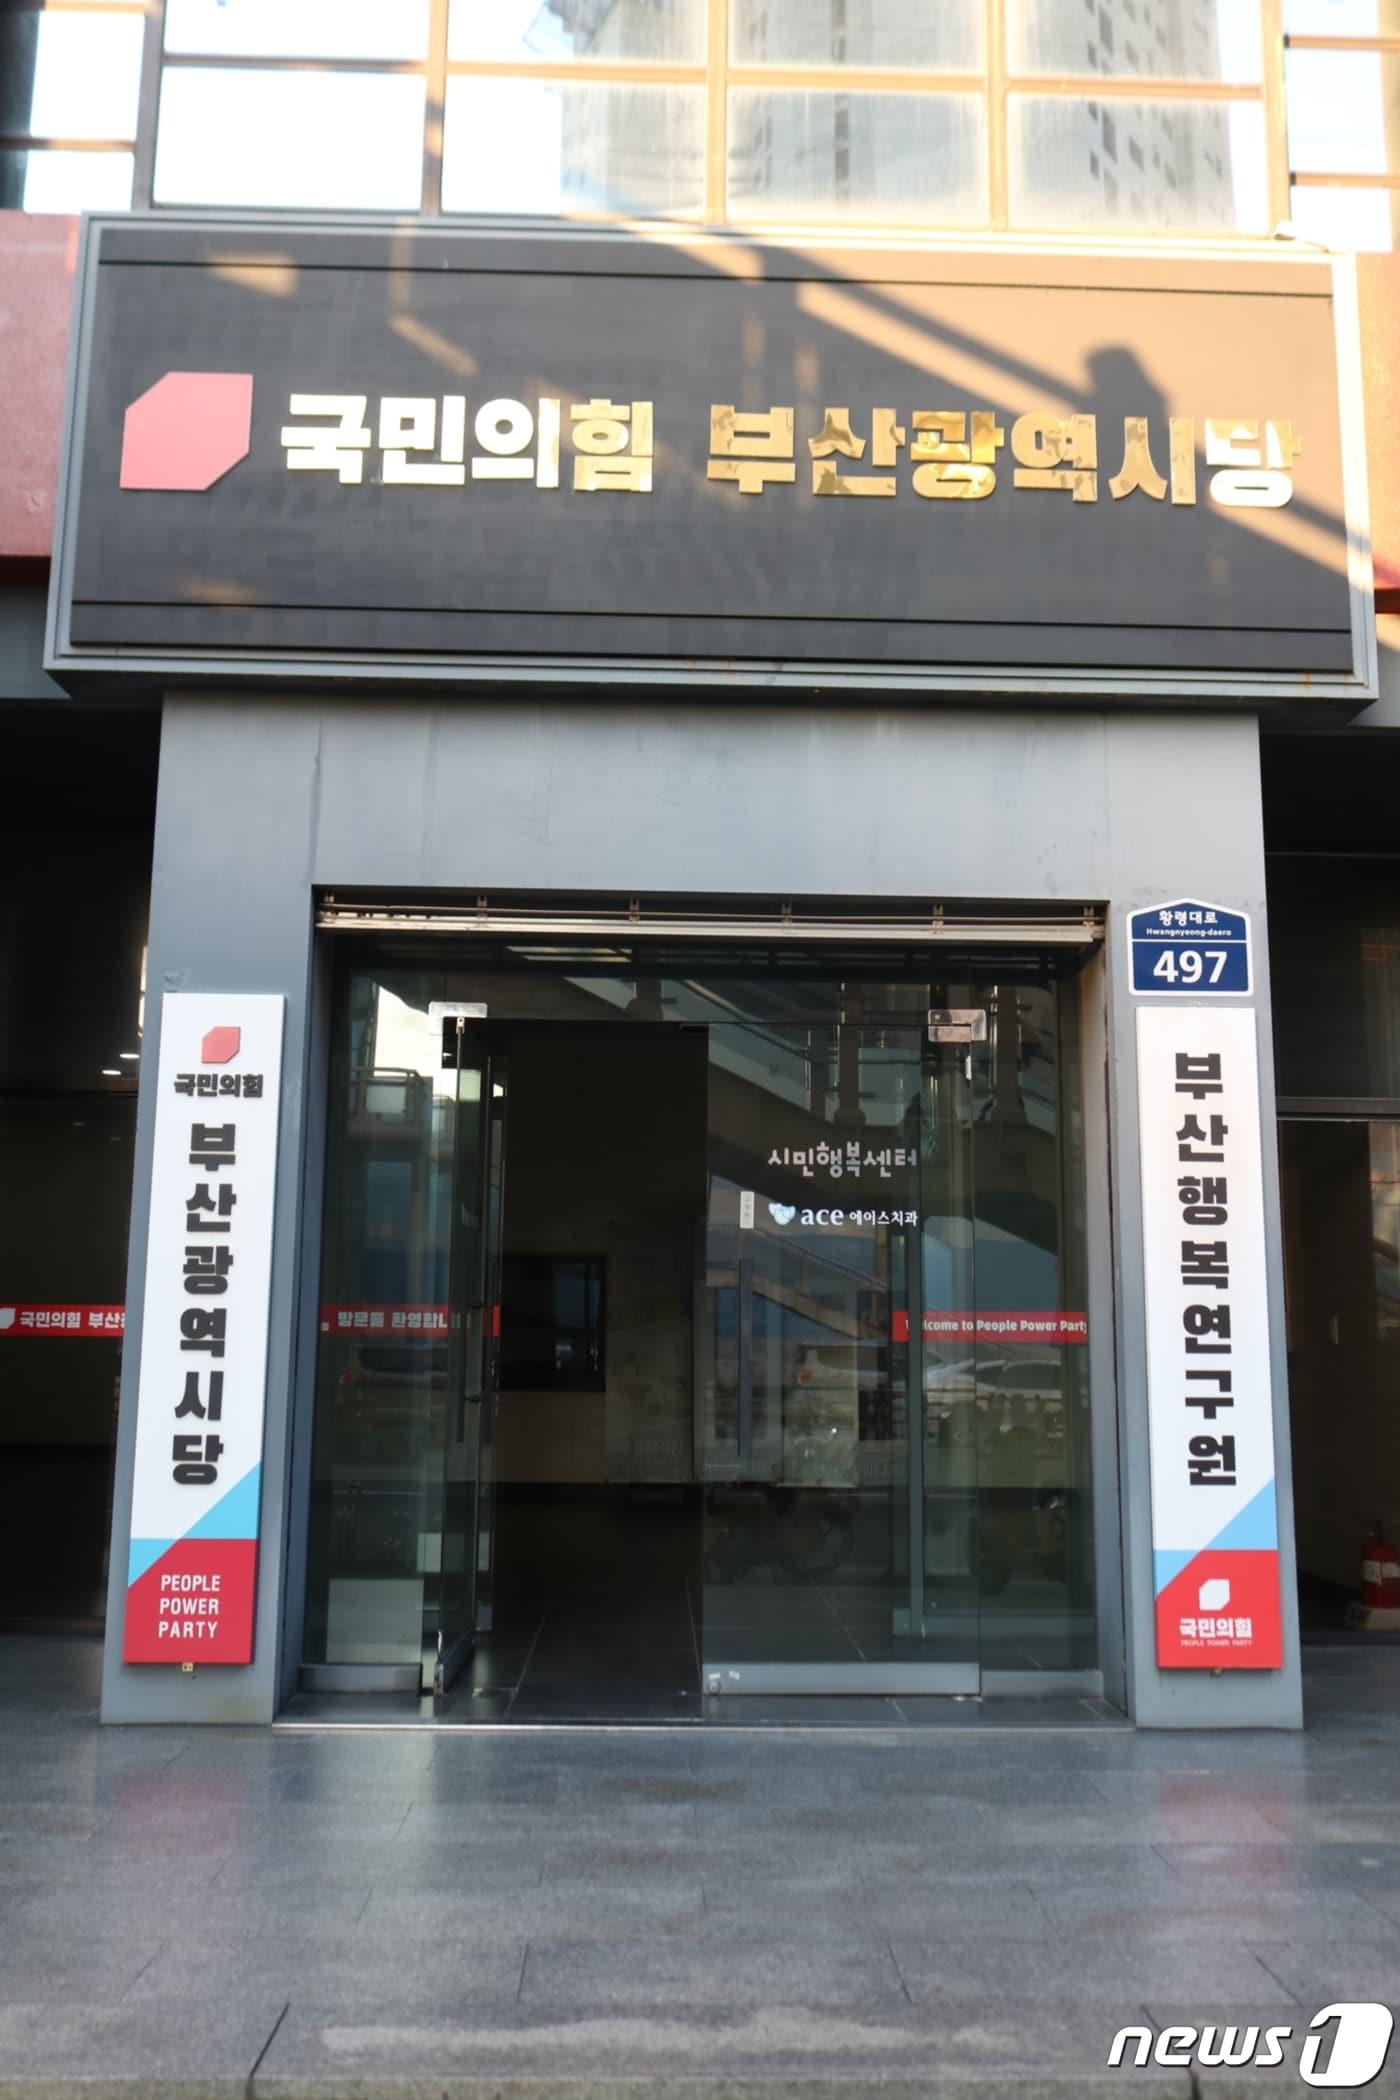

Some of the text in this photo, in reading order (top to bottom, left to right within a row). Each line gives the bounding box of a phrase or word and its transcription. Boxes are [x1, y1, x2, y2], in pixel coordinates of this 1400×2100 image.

[281, 394, 1301, 507] 국민의힘 부산광역시당
[1146, 928, 1232, 937] Hwangnyeong-daero
[1153, 950, 1228, 983] 497
[174, 1073, 264, 1098] 국민의힘
[768, 1141, 917, 1178] 시민행복센터
[801, 1208, 918, 1226] ace 에이스치과
[1175, 1053, 1237, 1485] 부산행복연구원
[172, 1123, 237, 1485] 부산광역시당
[20, 1312, 125, 1328] 국민의힘 부산
[338, 1312, 385, 1328] 방문을
[905, 1319, 958, 1331] lcome
[962, 1320, 974, 1331] to
[977, 1319, 1017, 1333] People
[1021, 1319, 1057, 1331] Power
[161, 1574, 221, 1592] PEOPLE
[159, 1597, 219, 1616] POWER
[158, 1621, 218, 1639] PARTY
[1179, 1617, 1252, 1638] 국민의힘
